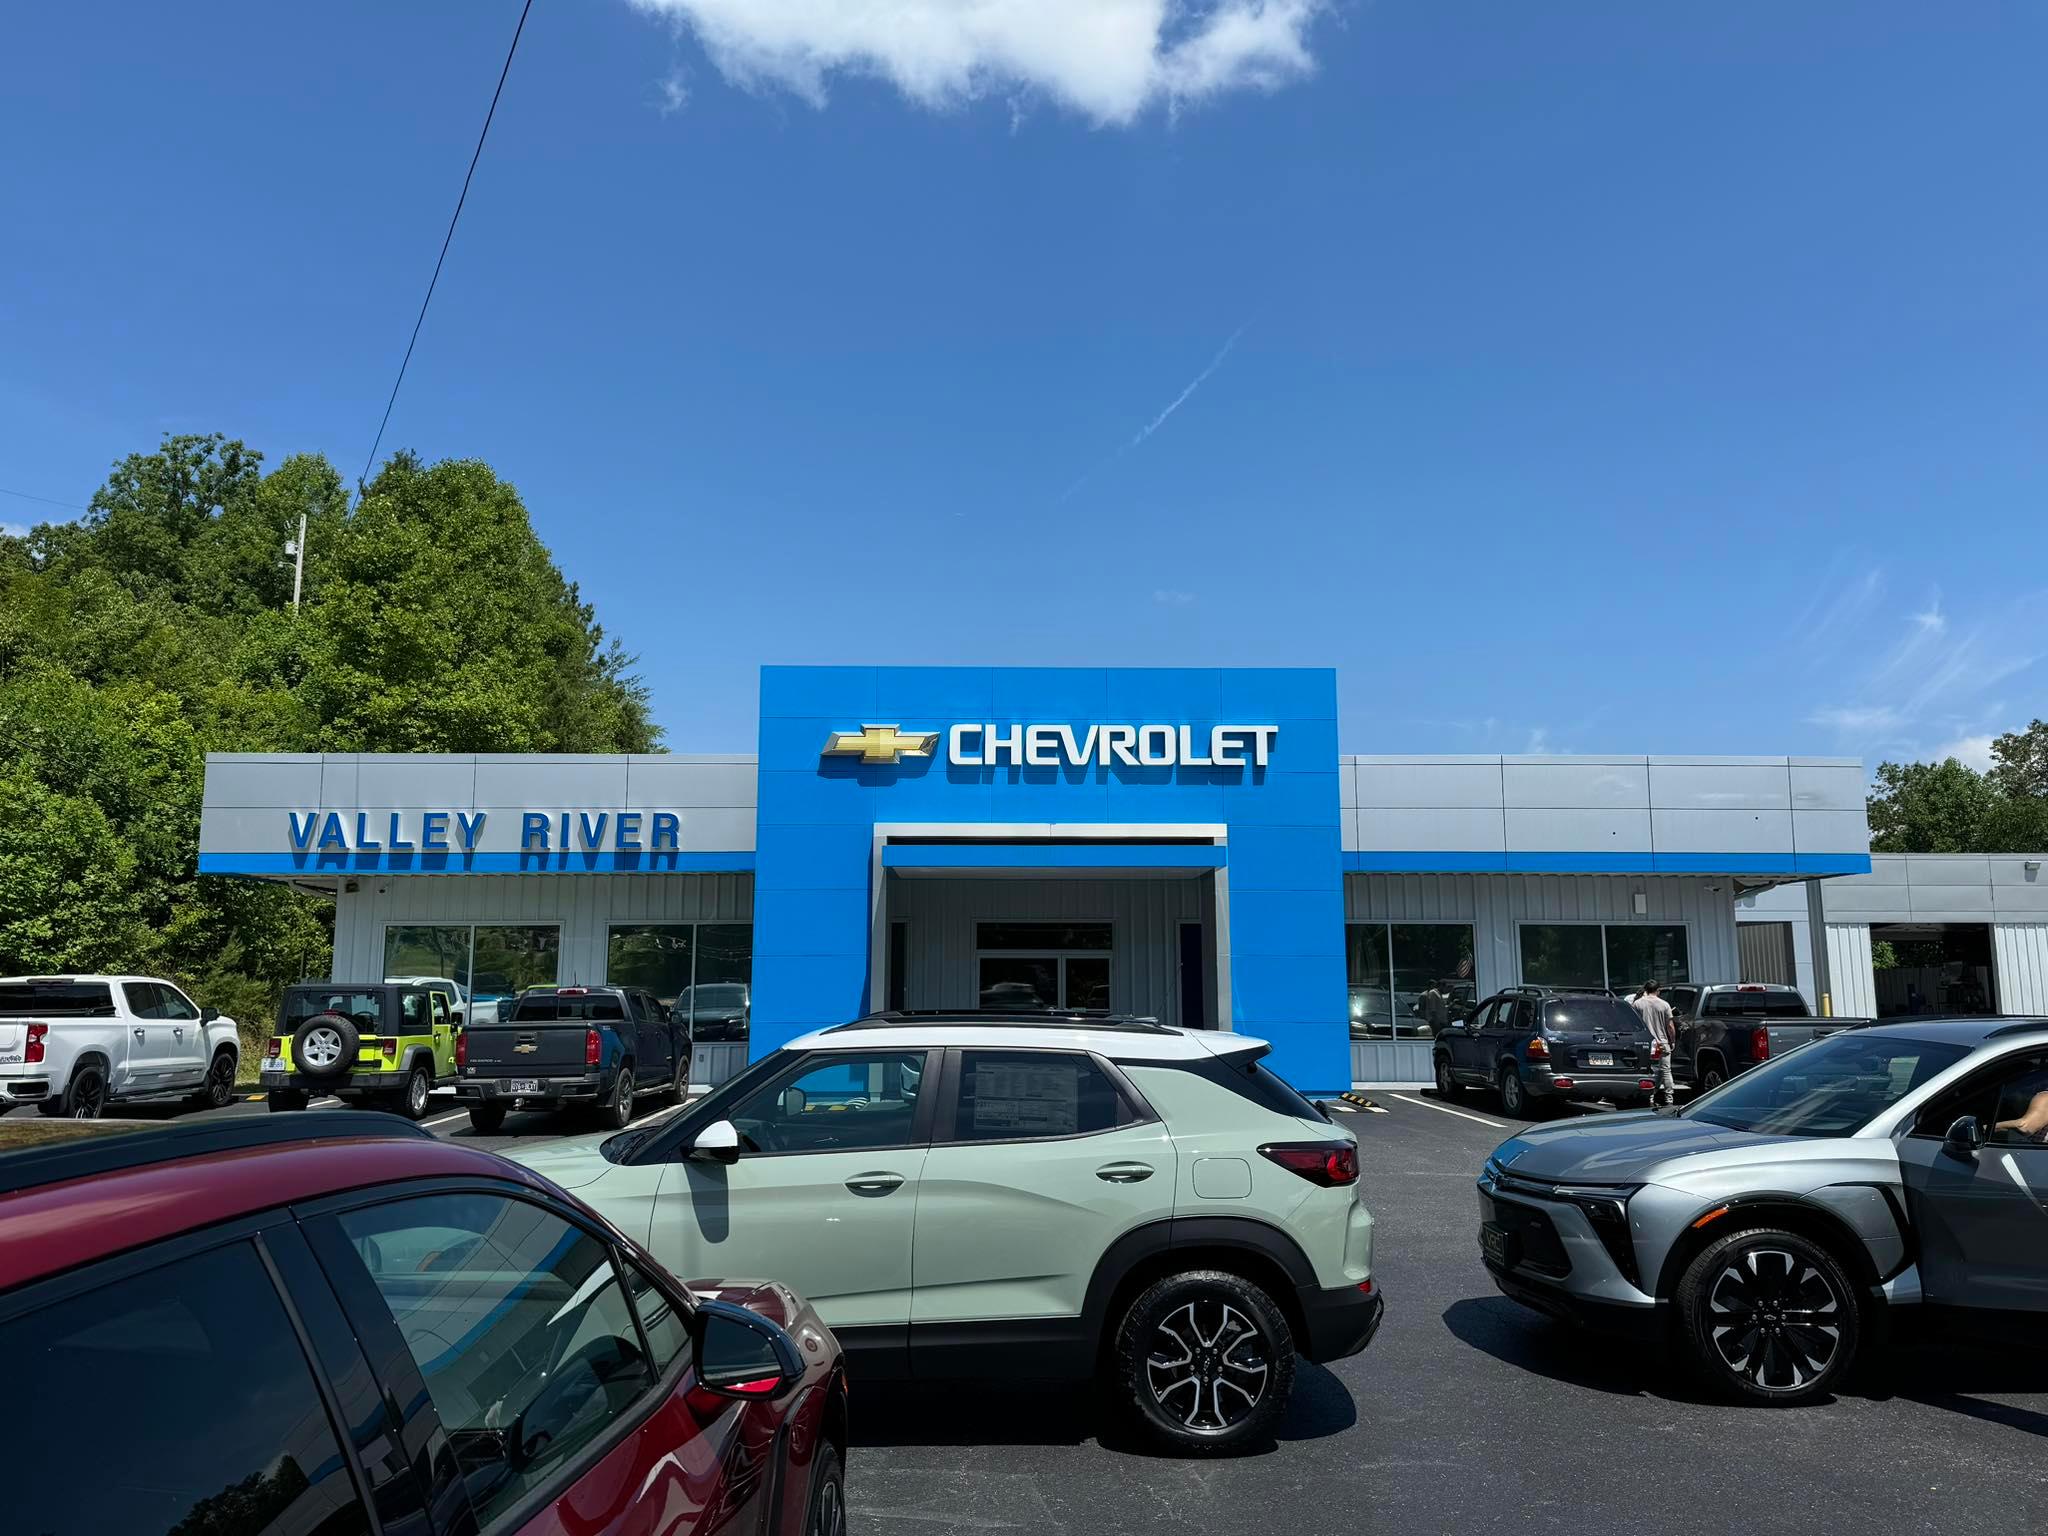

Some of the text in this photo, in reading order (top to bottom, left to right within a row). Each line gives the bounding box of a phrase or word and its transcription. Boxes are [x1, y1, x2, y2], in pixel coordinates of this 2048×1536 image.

[949, 724, 1279, 766] CHEVROLET
[288, 812, 681, 849] VALLEY RIVER
